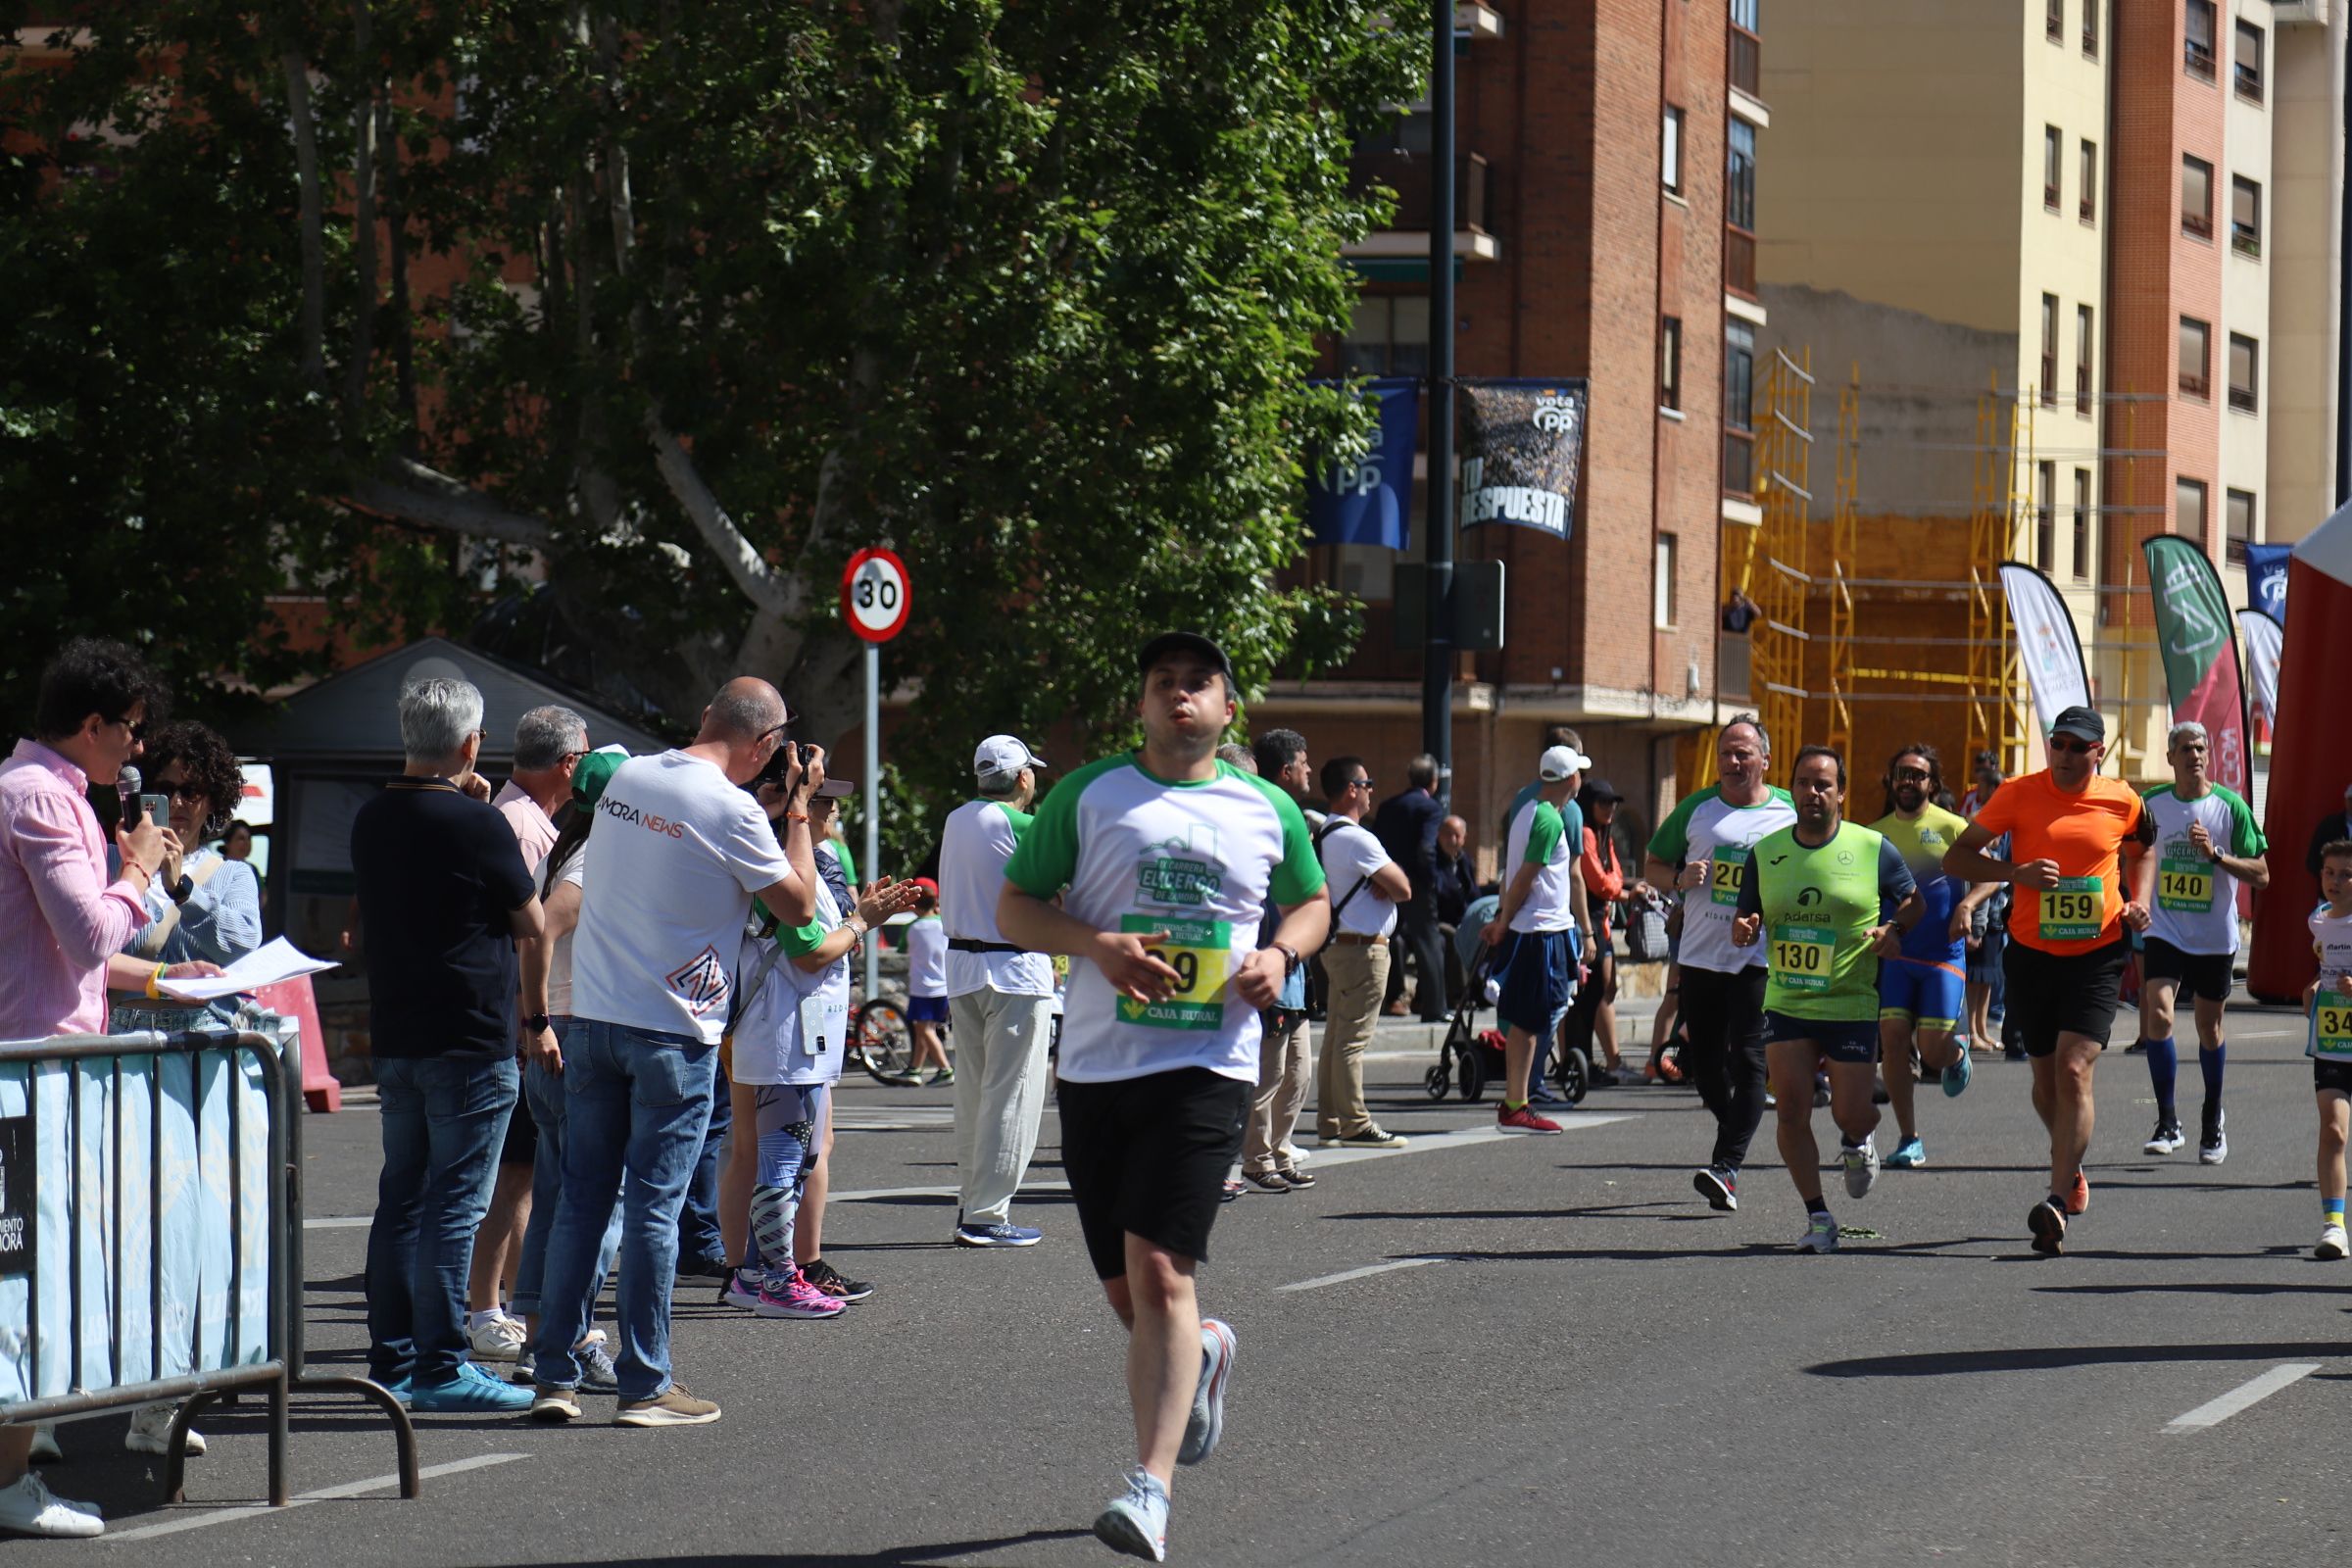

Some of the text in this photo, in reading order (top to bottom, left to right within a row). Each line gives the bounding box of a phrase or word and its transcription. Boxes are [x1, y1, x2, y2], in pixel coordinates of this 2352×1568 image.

[1535, 396, 1574, 408] vota
[1544, 413, 1573, 433] pp
[1337, 466, 1382, 496] pp
[1463, 457, 1484, 492] TU
[1461, 486, 1565, 532] RESPUESTA
[858, 578, 896, 610] 30
[641, 813, 684, 839] NEWS
[1142, 869, 1158, 887] EL
[2164, 874, 2202, 897] 140
[2044, 894, 2092, 919] 159
[1777, 944, 1820, 970] 130
[1148, 1006, 1218, 1023] CAJA RURAL
